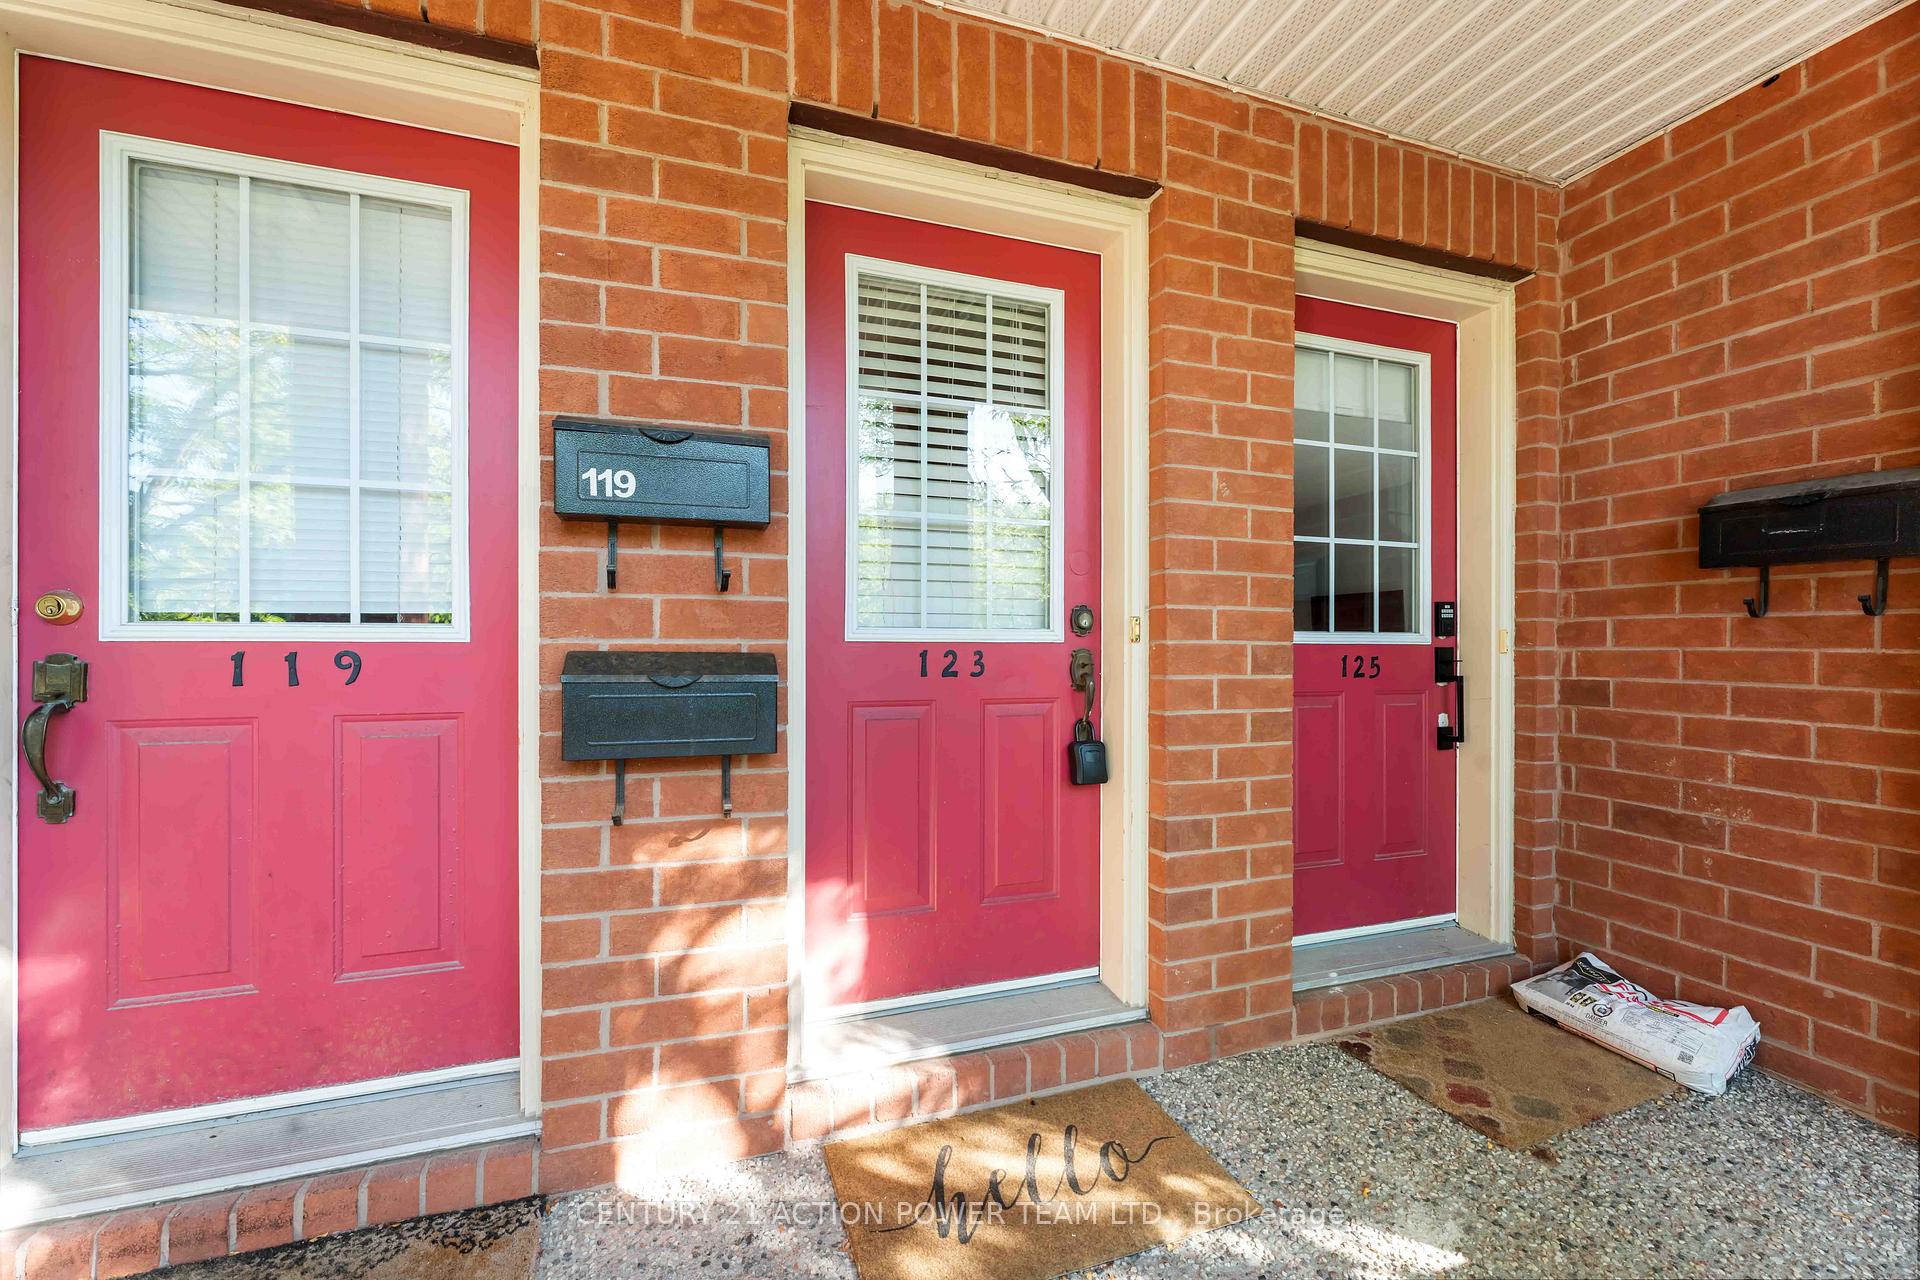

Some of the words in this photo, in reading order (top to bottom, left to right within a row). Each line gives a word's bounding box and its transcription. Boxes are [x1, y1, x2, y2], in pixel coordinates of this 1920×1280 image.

[581, 467, 637, 498] 119
[230, 650, 362, 687] 119
[919, 649, 986, 678] 123
[1341, 654, 1381, 679] 125
[1584, 1012, 1609, 1027] DANGER
[868, 1124, 1177, 1245] hello
